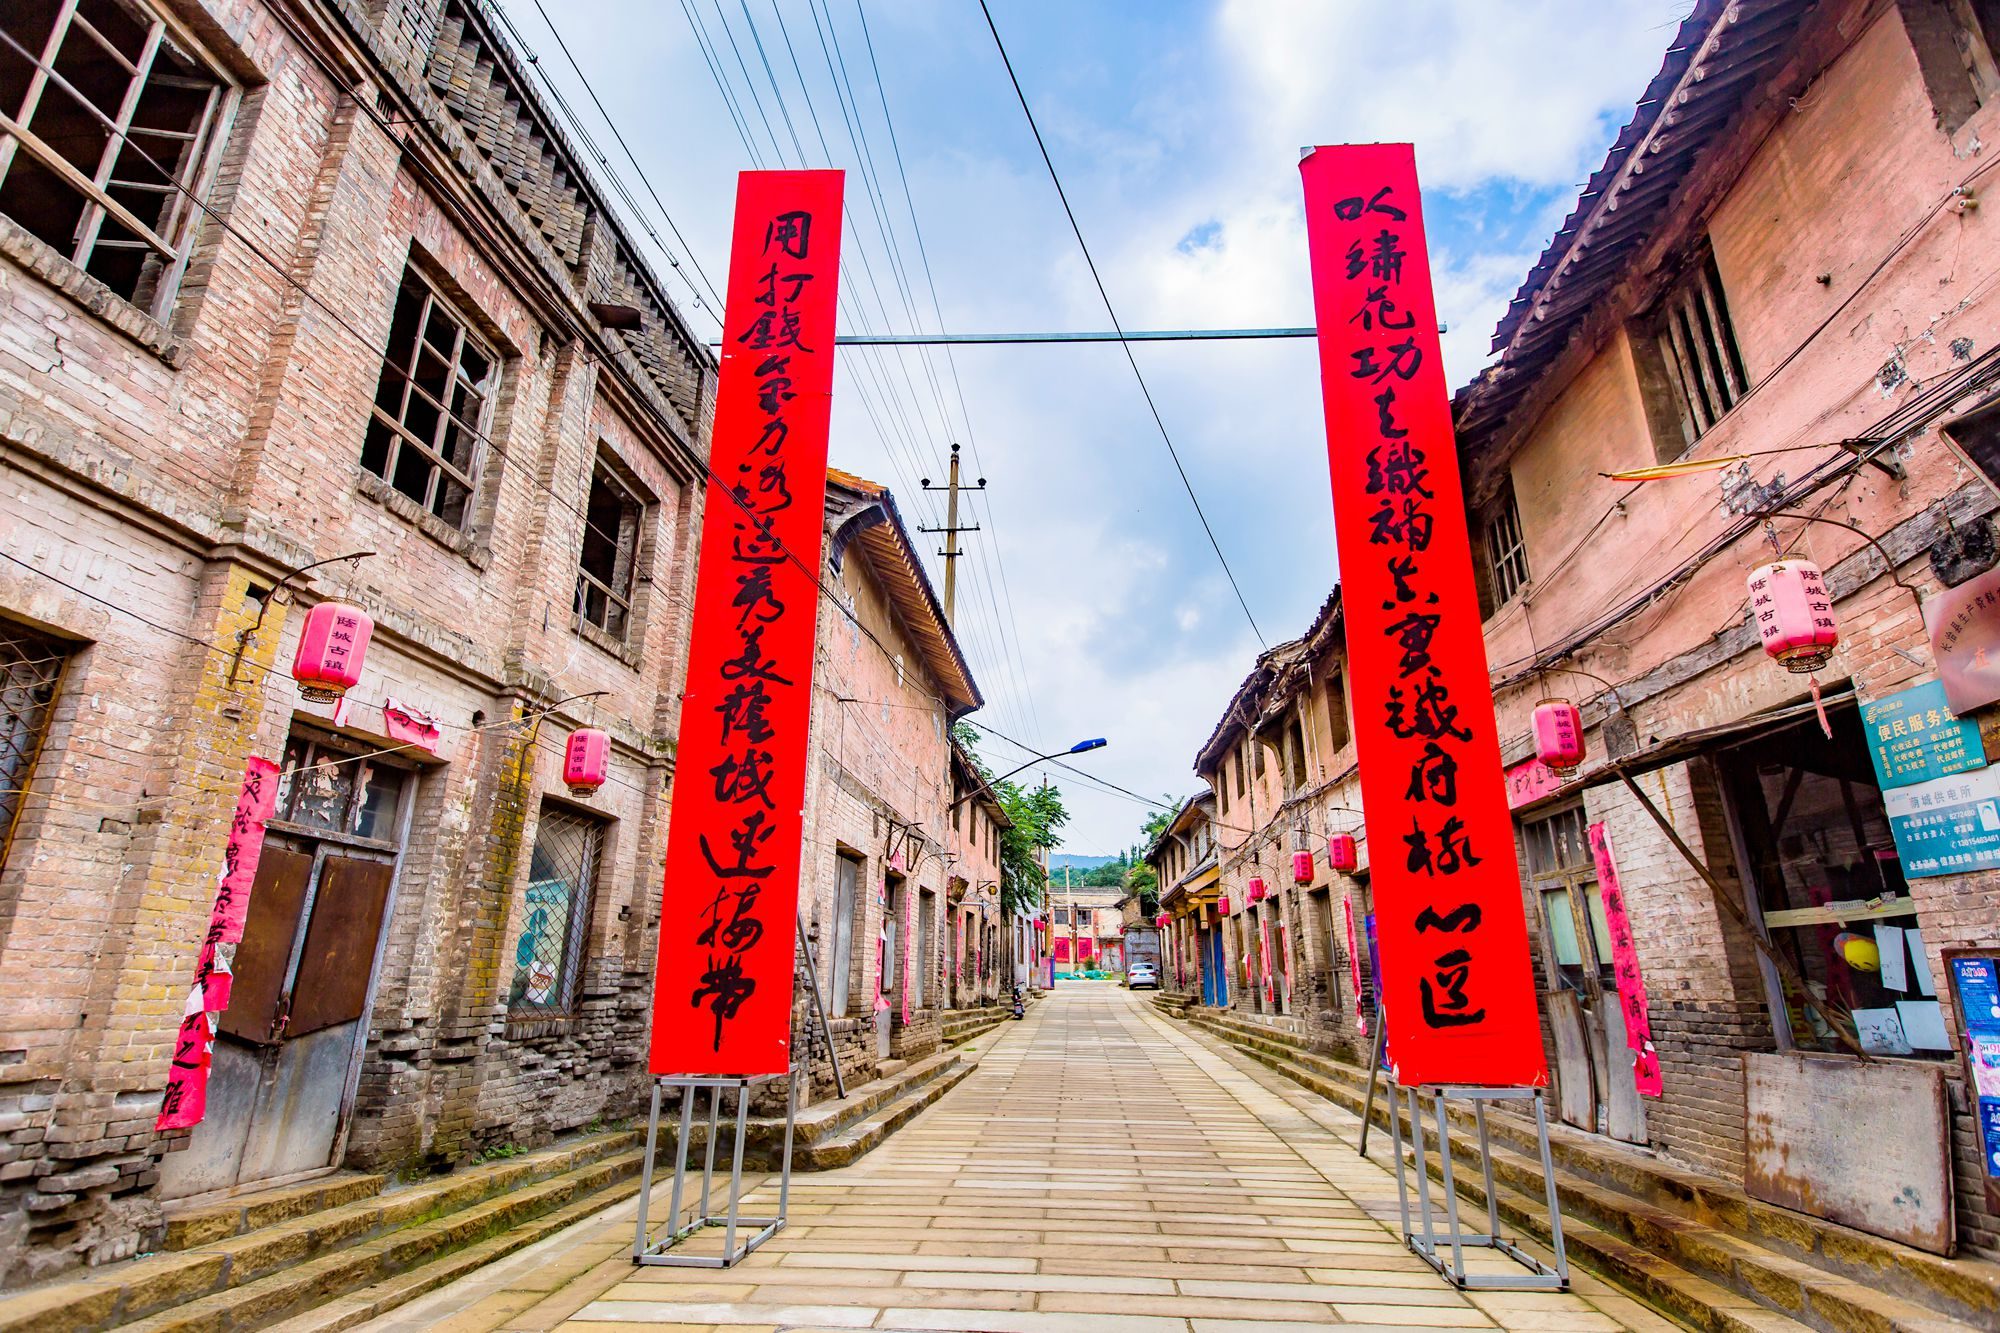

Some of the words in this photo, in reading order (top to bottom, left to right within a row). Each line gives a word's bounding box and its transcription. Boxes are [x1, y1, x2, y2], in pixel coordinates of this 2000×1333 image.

[1940, 587, 2000, 653] 长治县生产资料
